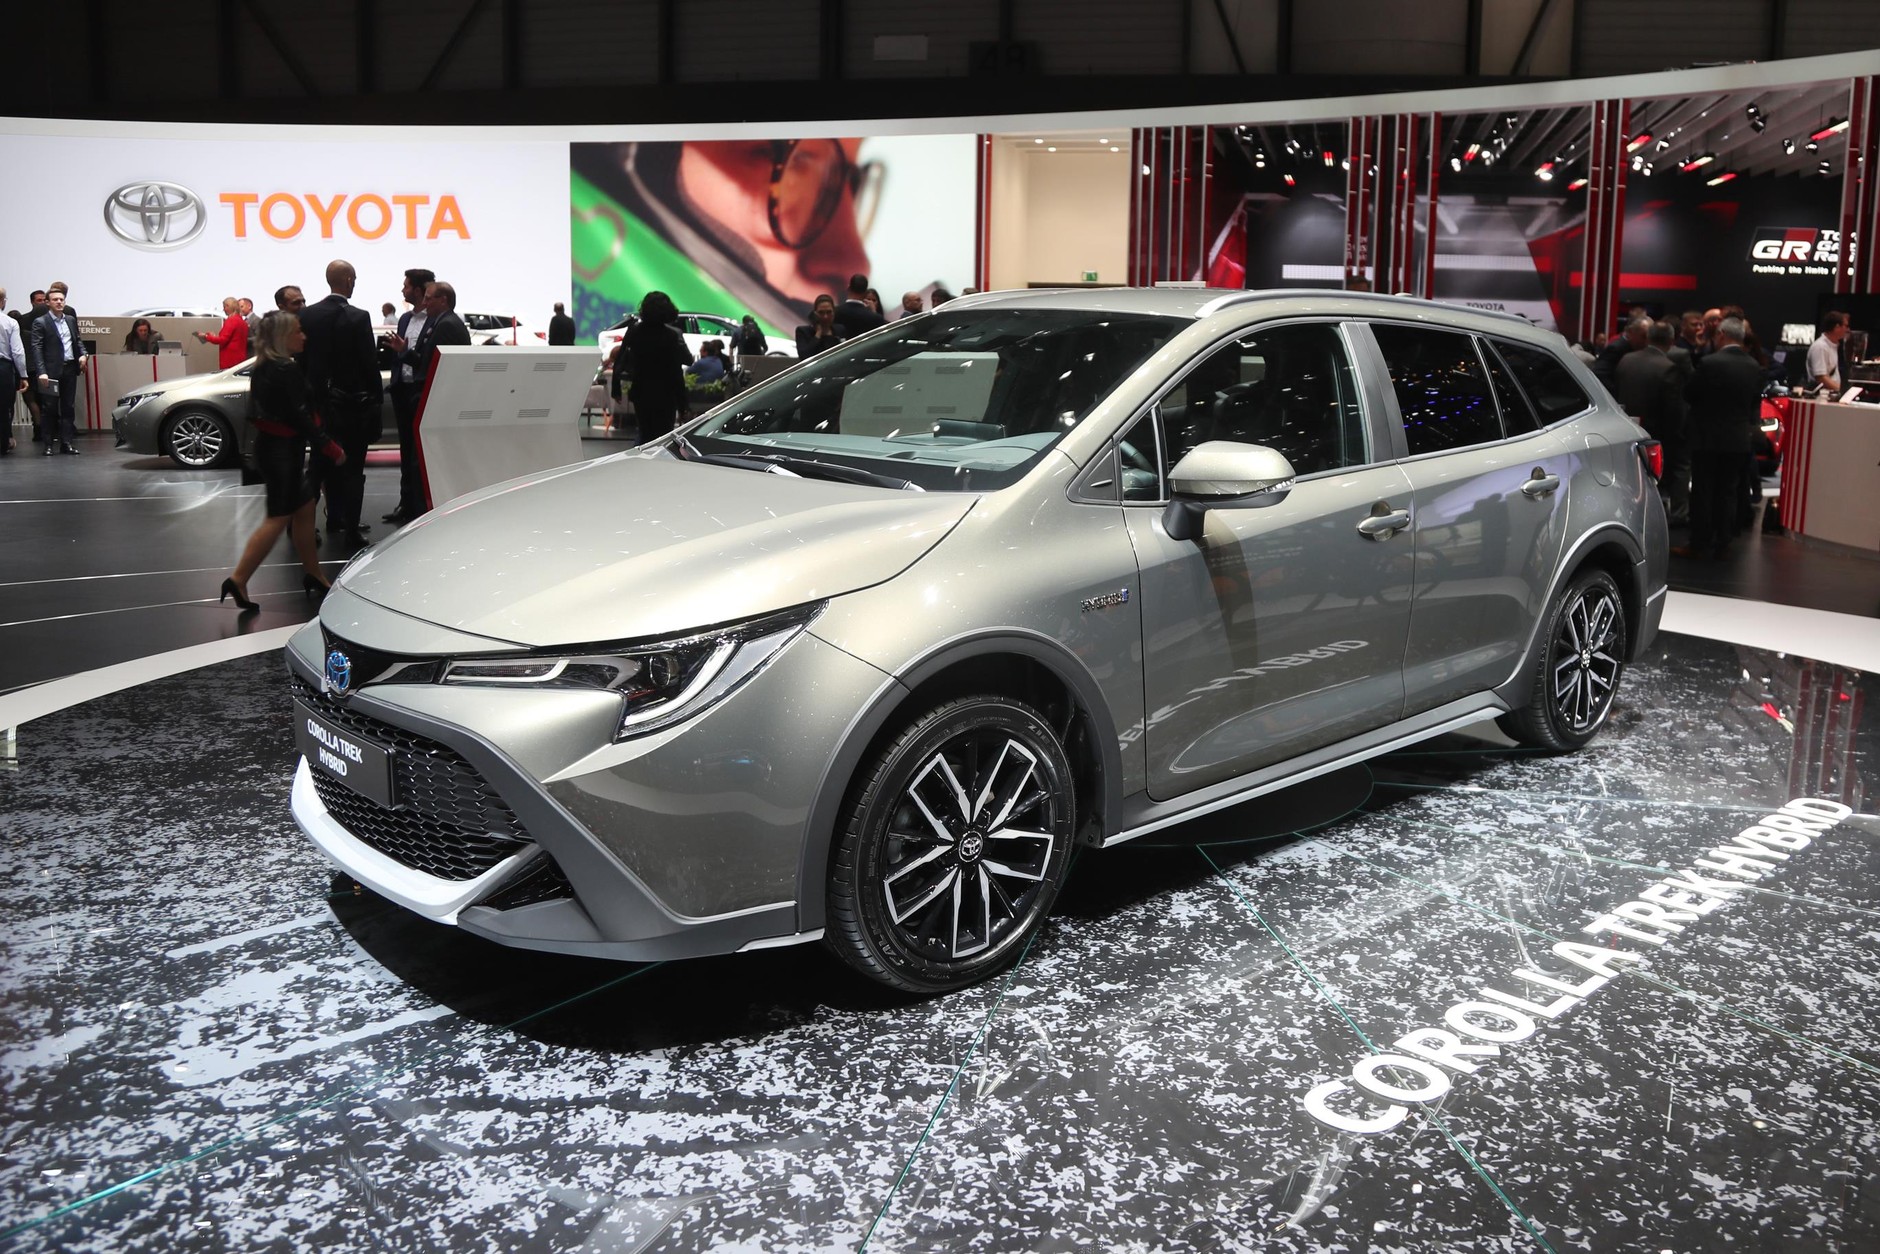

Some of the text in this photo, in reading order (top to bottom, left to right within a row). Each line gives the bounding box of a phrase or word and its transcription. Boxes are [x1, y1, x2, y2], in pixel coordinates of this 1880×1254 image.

[219, 192, 471, 240] TOYOTA
[1752, 240, 1811, 260] GR
[1466, 302, 1505, 311] TOYOTA
[307, 718, 363, 764] COROLLA TREK
[319, 746, 347, 776] HYBRID
[1303, 797, 1853, 1134] COROLLA TREK HYBRID
